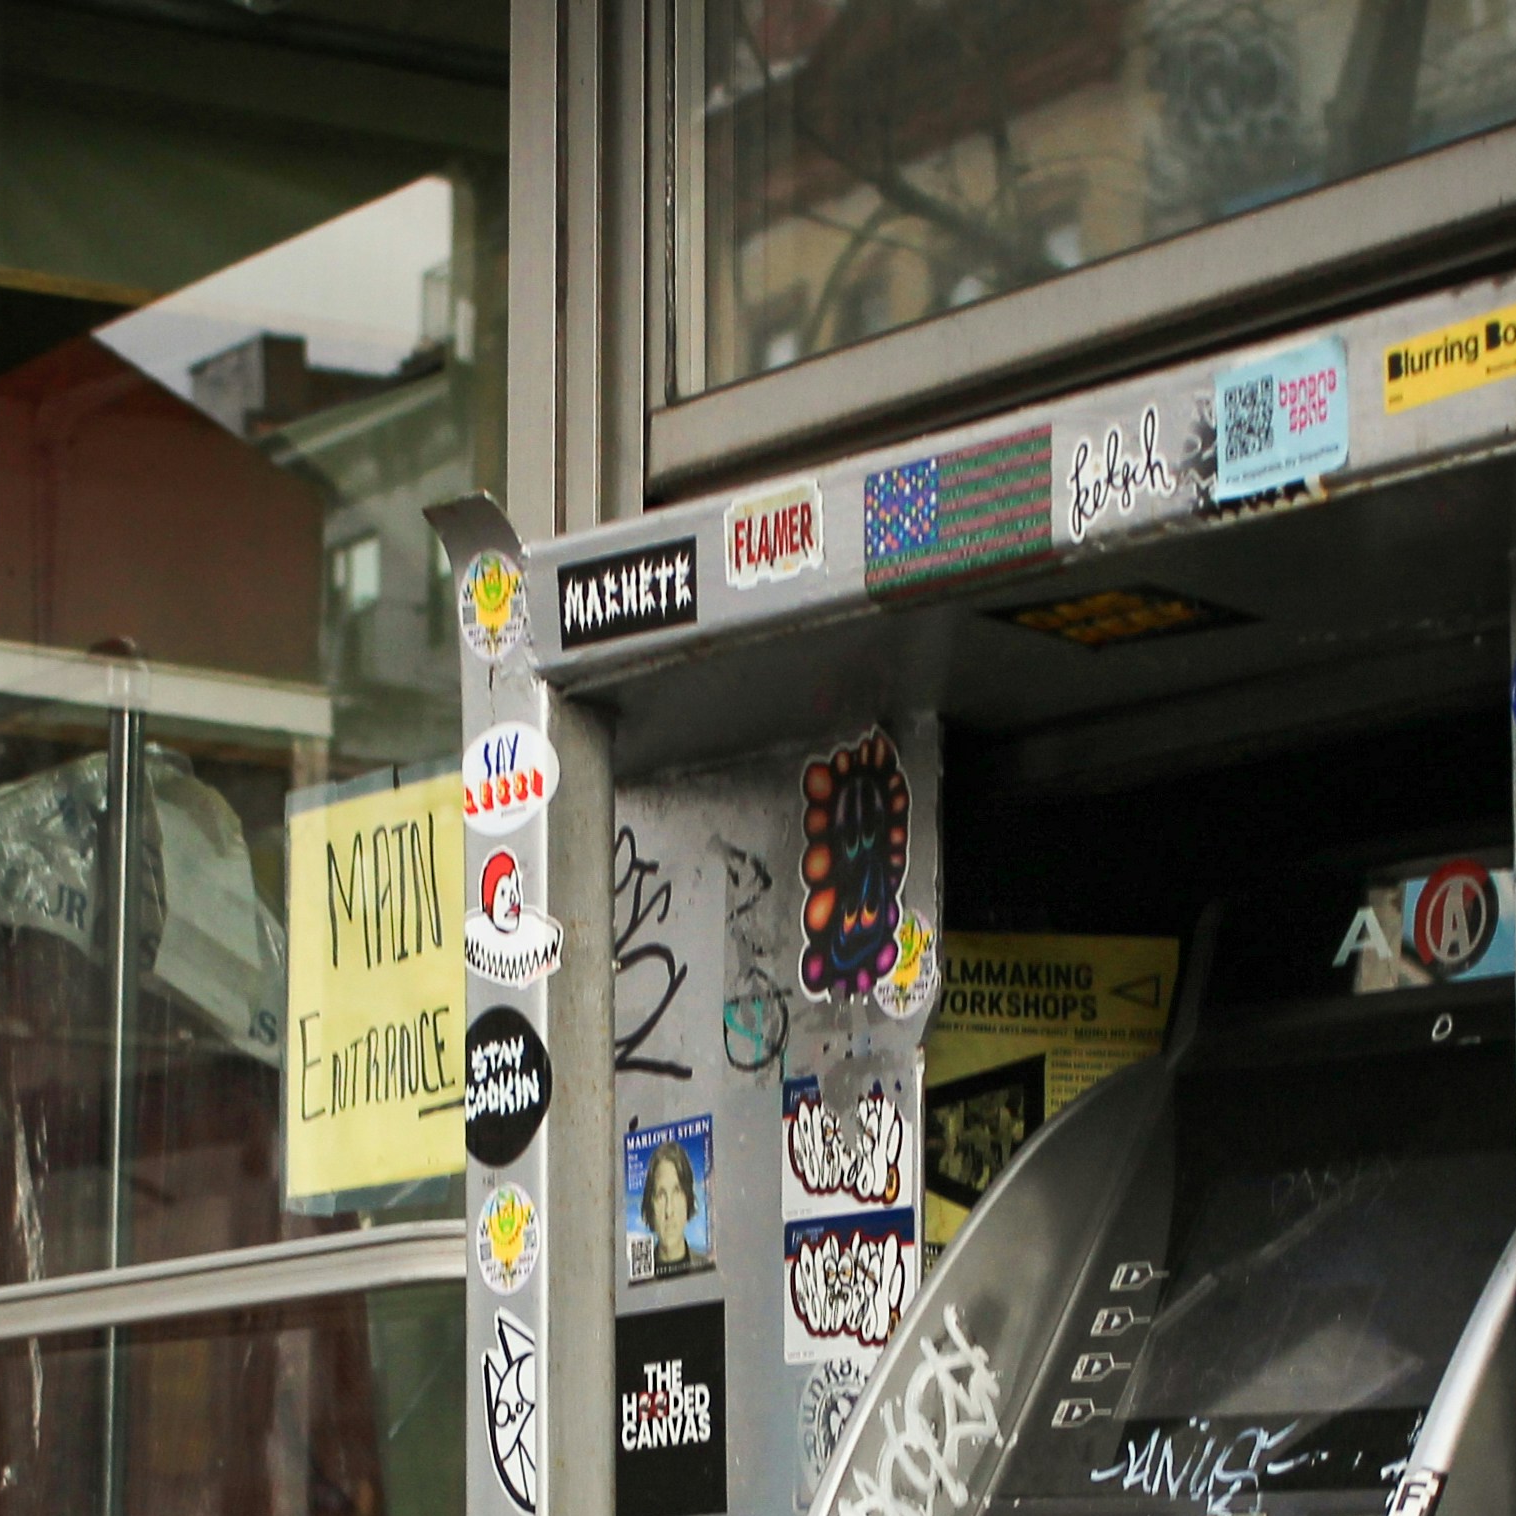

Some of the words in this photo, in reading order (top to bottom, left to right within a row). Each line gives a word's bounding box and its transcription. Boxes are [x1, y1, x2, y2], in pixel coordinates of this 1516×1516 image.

[1388, 335, 1479, 382] Blurring
[1278, 366, 1338, 408] banana
[734, 502, 815, 575] FLAMER
[564, 551, 692, 635] MACHETE
[483, 731, 519, 780] SAY
[326, 812, 443, 970] MAIN
[944, 957, 1094, 991] LMMAKING
[299, 1006, 456, 1123] ENTRANCE
[471, 1034, 525, 1080] STAY
[626, 1126, 675, 1152] MARLOWE
[643, 1360, 683, 1395] THE
[621, 1408, 712, 1451] CANVAS
